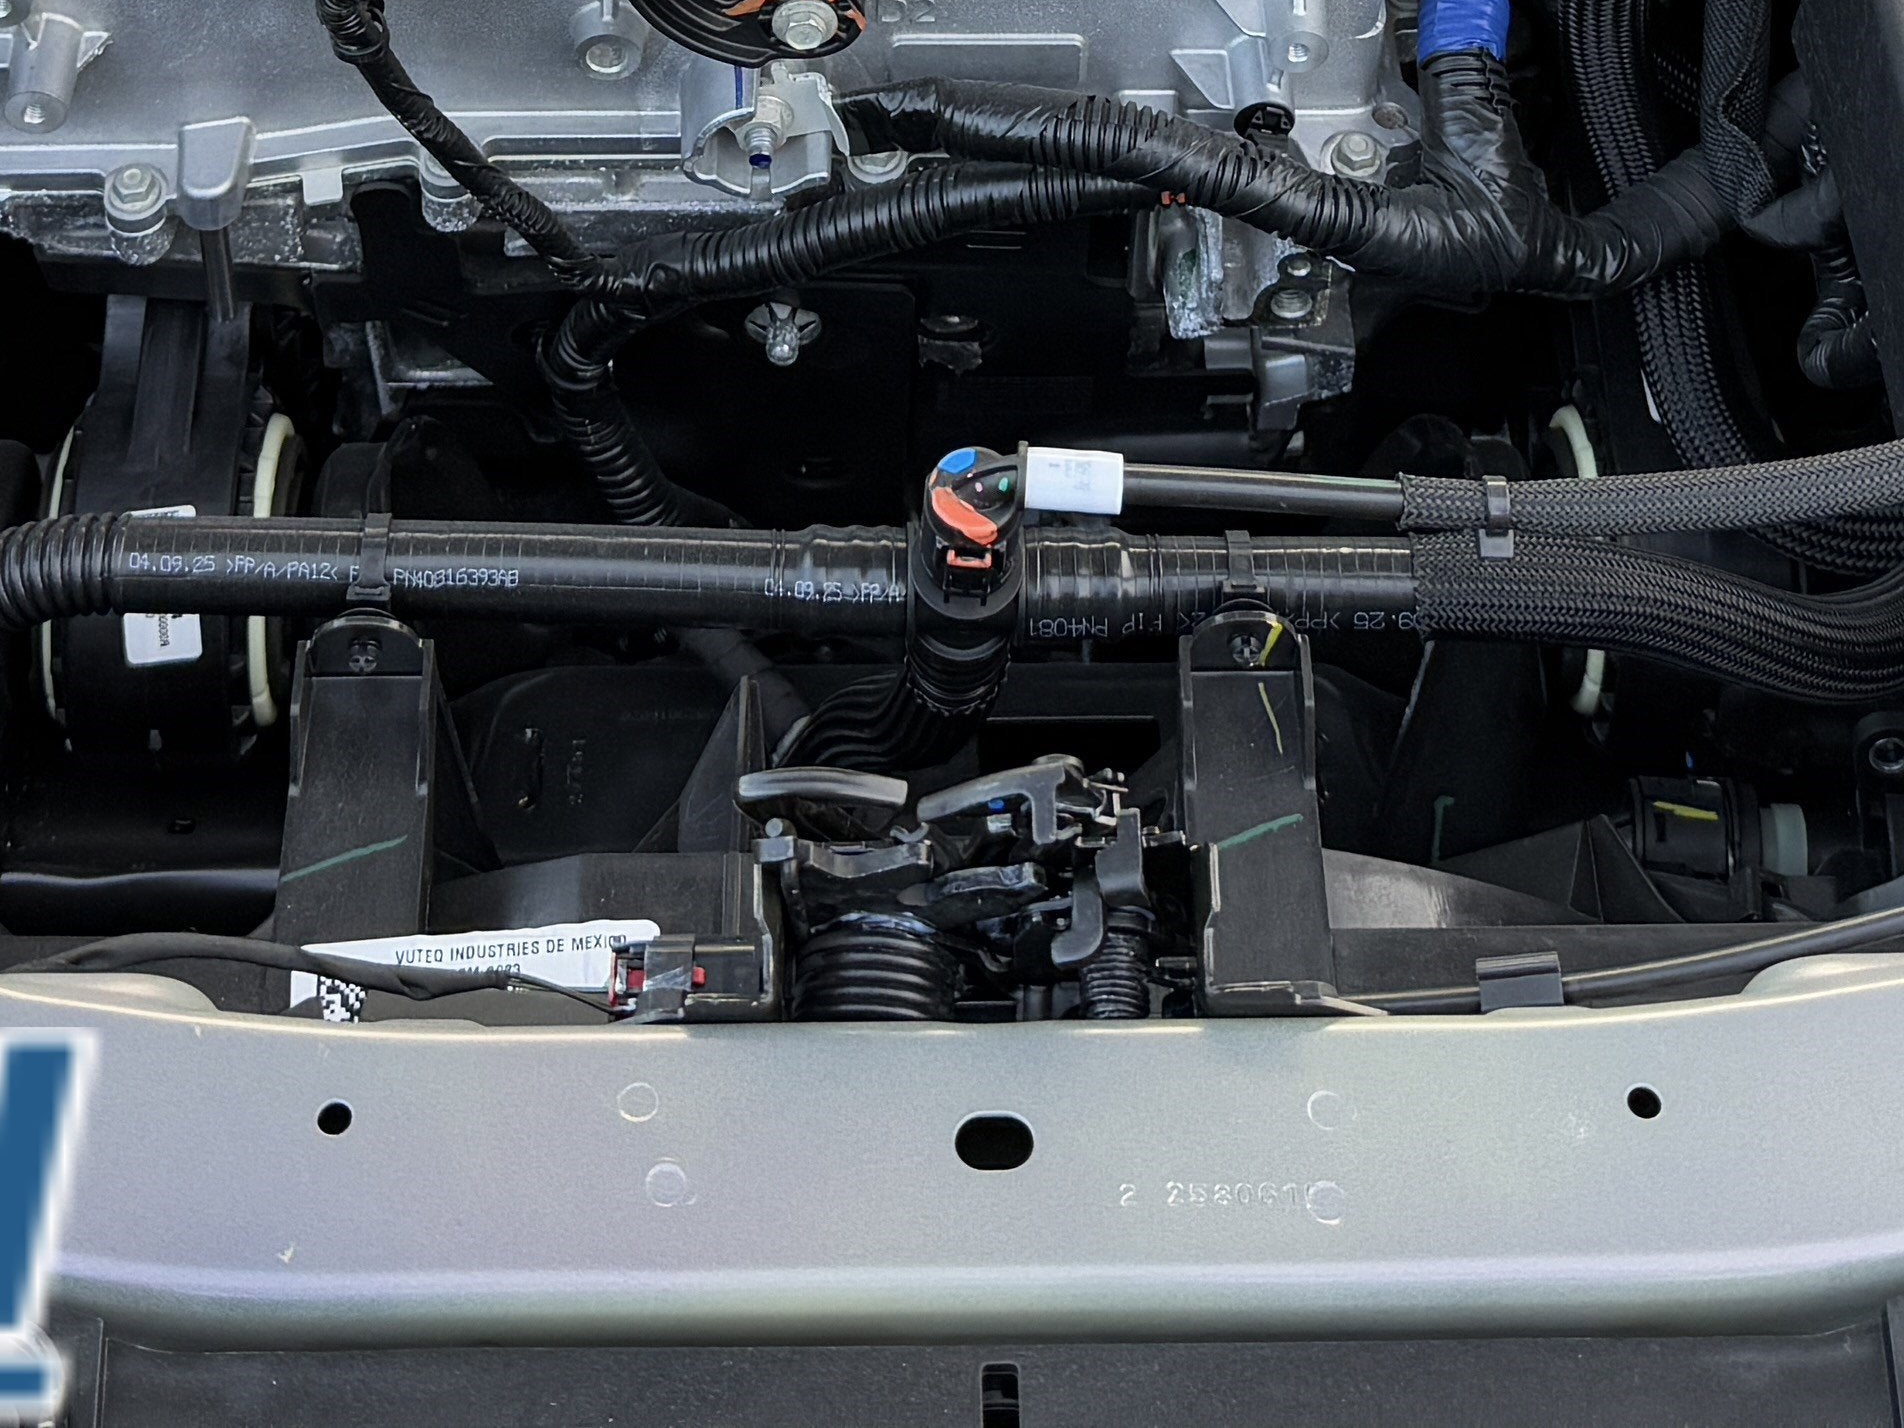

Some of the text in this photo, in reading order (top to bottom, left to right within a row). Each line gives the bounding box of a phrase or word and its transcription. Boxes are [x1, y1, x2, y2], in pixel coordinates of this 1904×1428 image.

[129, 552, 215, 573] 04.09.25
[1027, 615, 1109, 639] PN4081
[396, 948, 443, 966] VUTEQ
[449, 941, 540, 962] INDUSTRIES
[546, 938, 565, 954] DE
